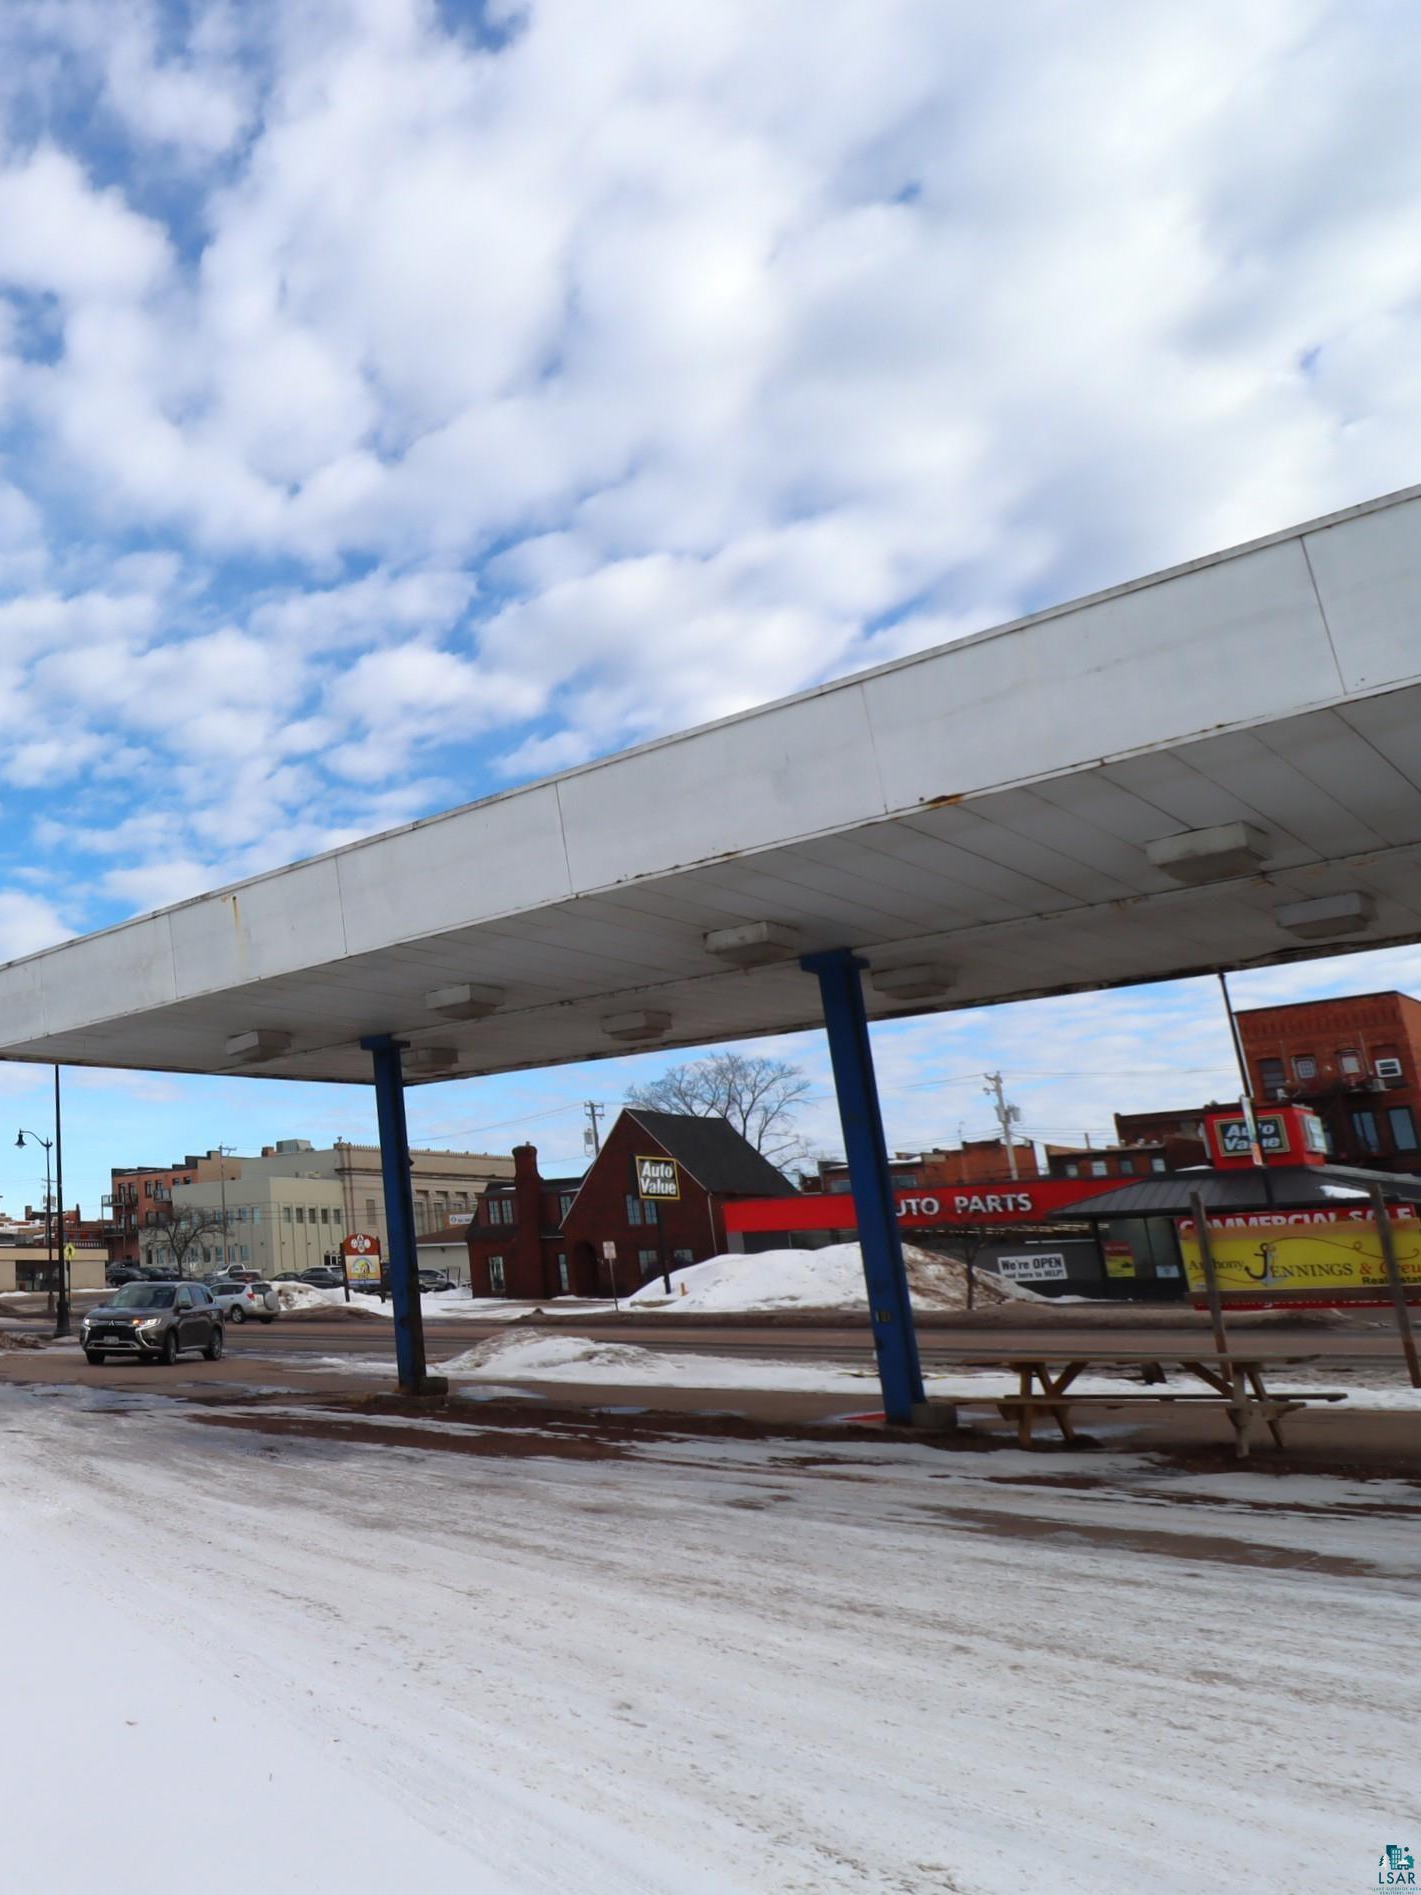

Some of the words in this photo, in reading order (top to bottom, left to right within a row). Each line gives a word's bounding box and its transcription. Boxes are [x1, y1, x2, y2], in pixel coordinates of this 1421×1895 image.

[1227, 1124, 1275, 1137] Ao
[1223, 1138, 1280, 1151] Vae
[641, 1161, 673, 1178] Auto
[641, 1178, 677, 1195] Value
[896, 1197, 940, 1216] UTO
[954, 1193, 1033, 1214] PARTS
[1001, 1259, 1029, 1270] We're
[1033, 1256, 1062, 1269] OPEN
[1188, 1257, 1244, 1272] Ahony
[1360, 1263, 1372, 1275] &
